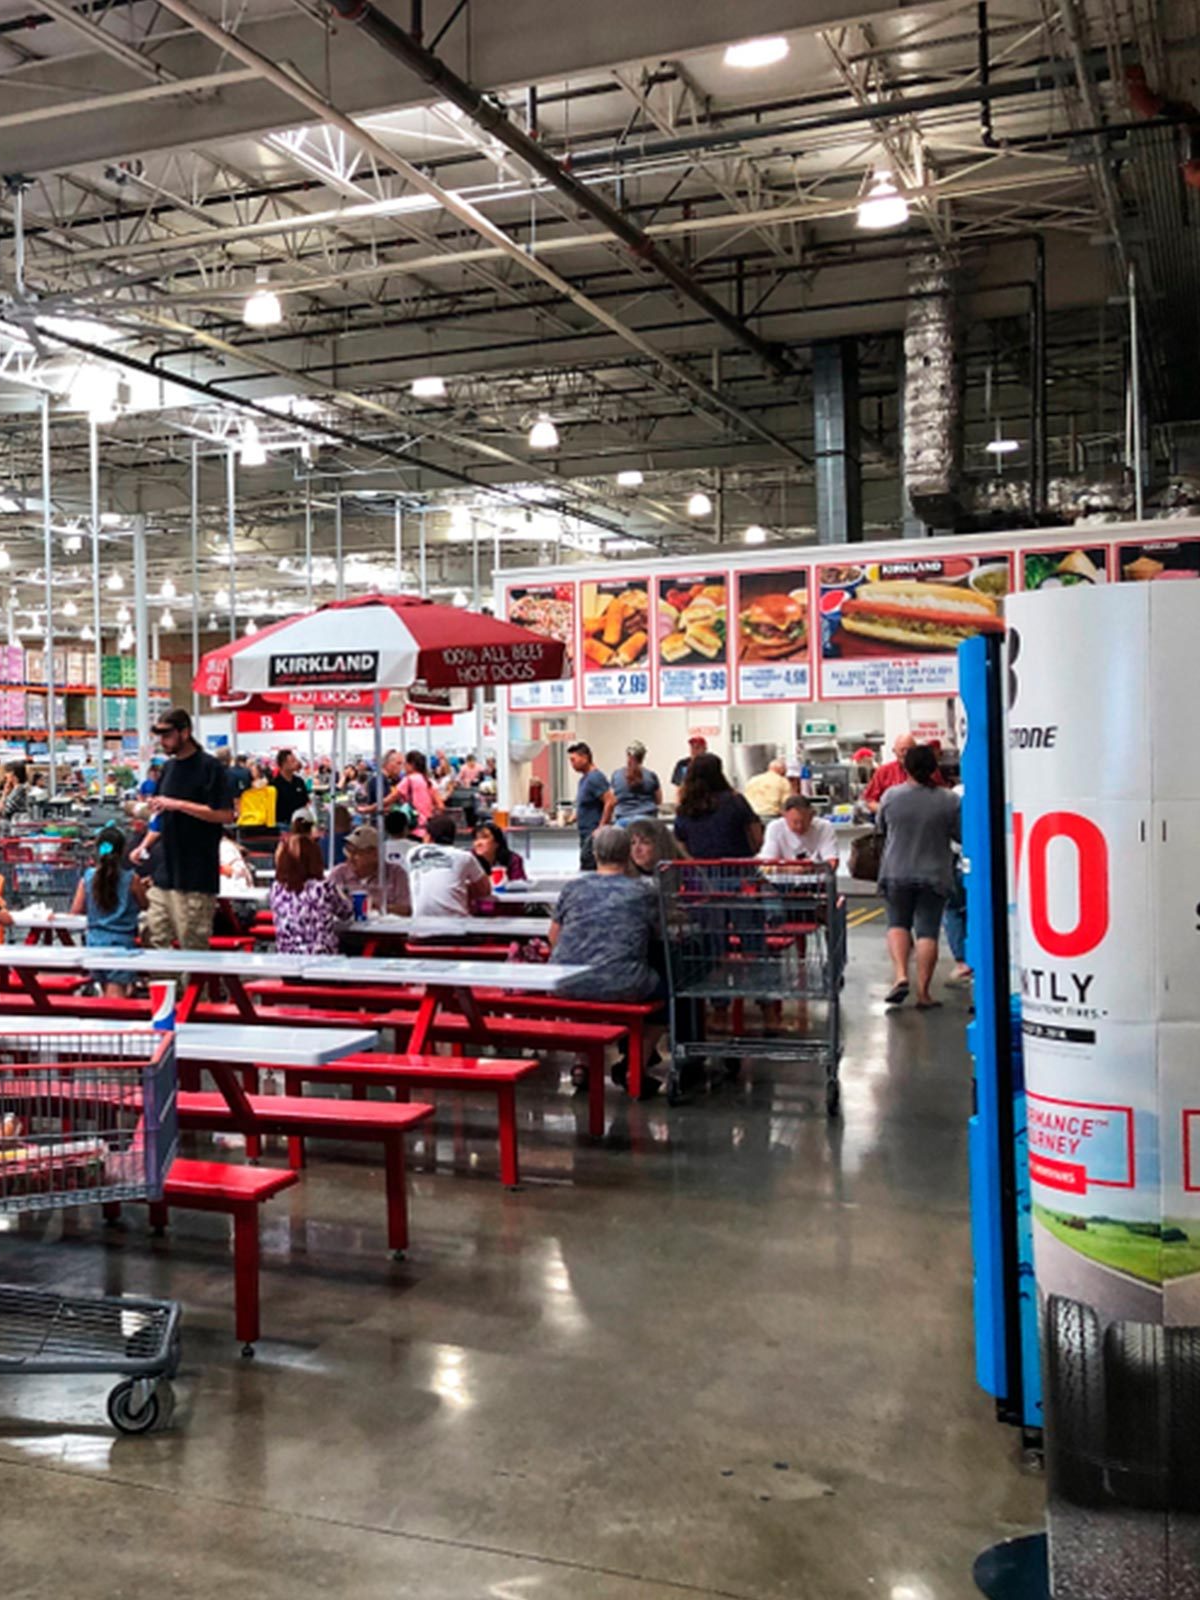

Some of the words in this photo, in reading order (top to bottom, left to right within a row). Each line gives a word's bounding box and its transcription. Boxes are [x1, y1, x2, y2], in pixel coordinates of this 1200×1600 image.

[481, 645, 508, 661] ALL
[512, 643, 544, 660] BEEF
[275, 654, 375, 674] KIRKLAND
[457, 666, 489, 682] HOT
[491, 663, 536, 680] DOGS
[618, 674, 648, 695] 2.99
